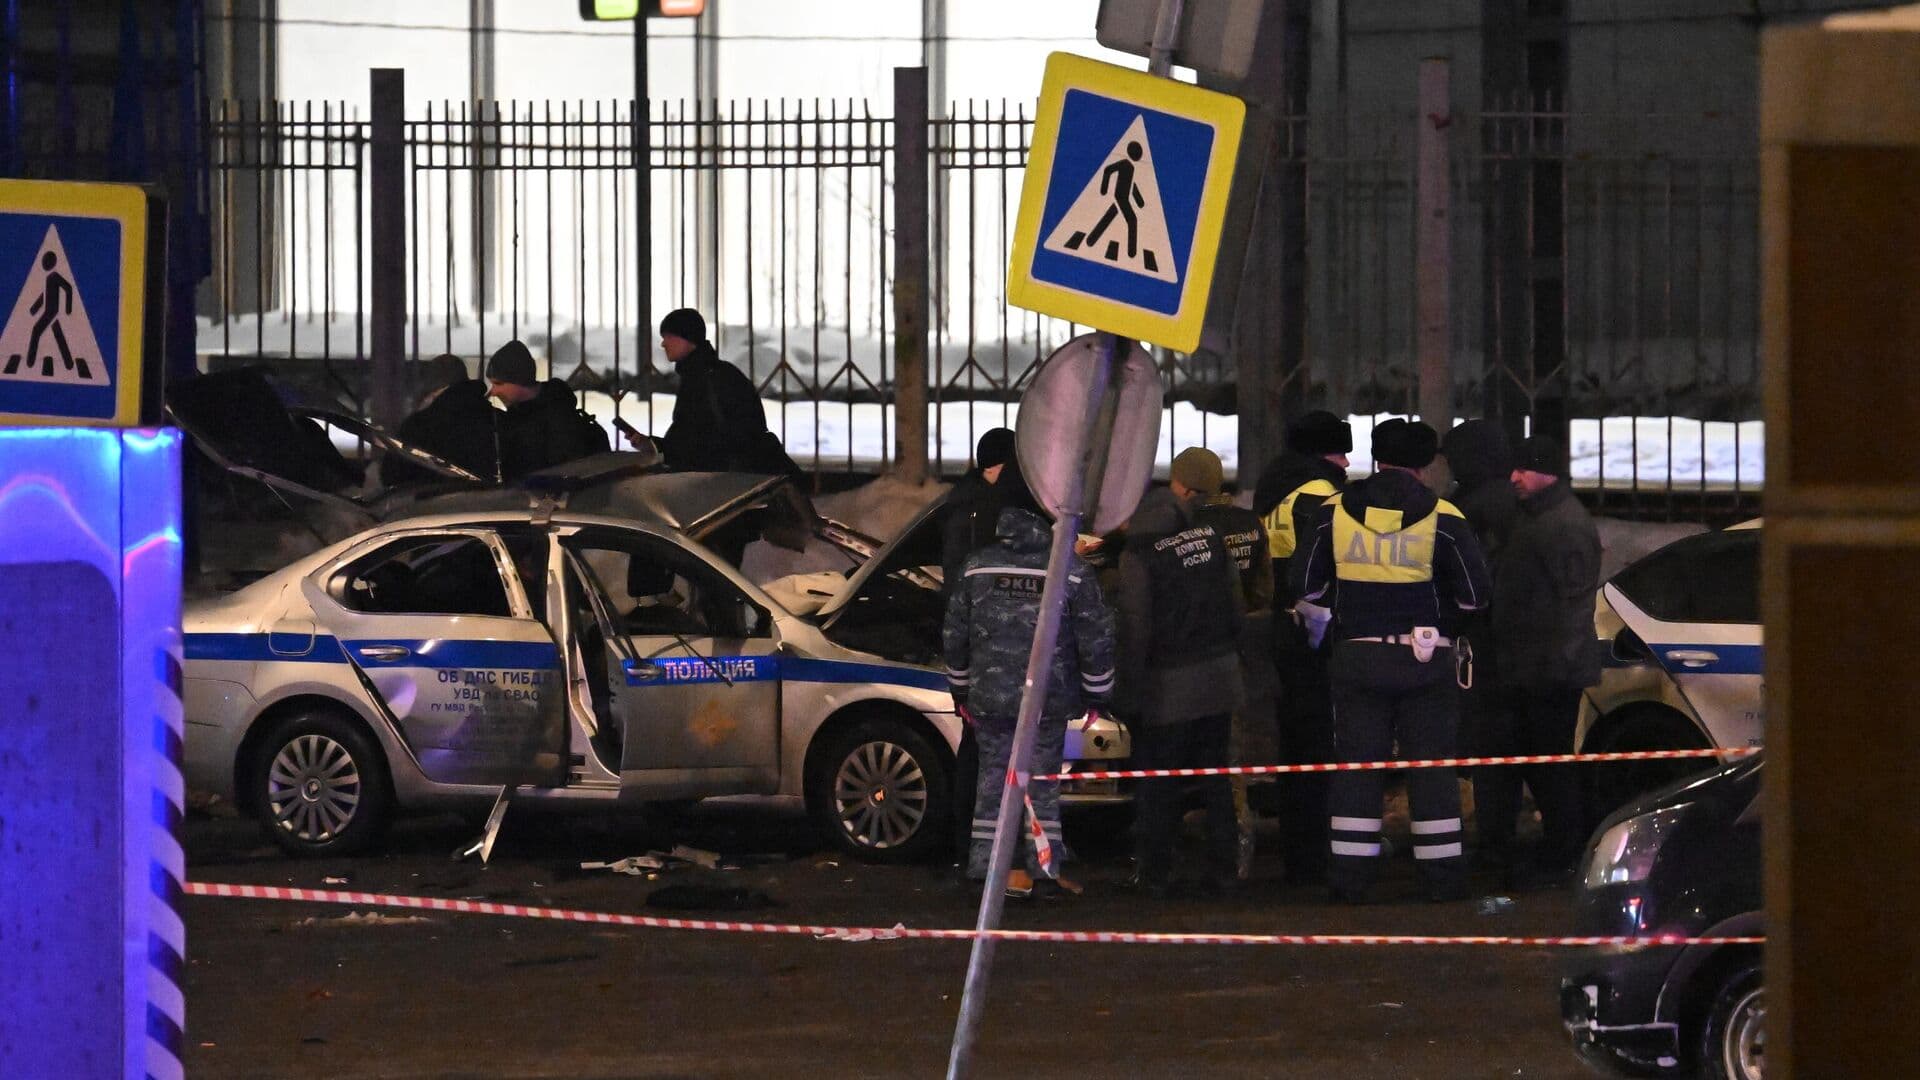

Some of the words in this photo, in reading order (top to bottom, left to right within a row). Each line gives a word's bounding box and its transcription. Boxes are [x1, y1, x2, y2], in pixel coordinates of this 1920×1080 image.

[1344, 530, 1423, 567] ДПС
[998, 577, 1037, 592] ЭКЦ
[438, 670, 458, 683] ОБ
[464, 671, 496, 685] ДПС
[665, 659, 755, 681] ПОЛИЦИЯ
[454, 687, 480, 700] УВД
[504, 689, 540, 701] СВАО
